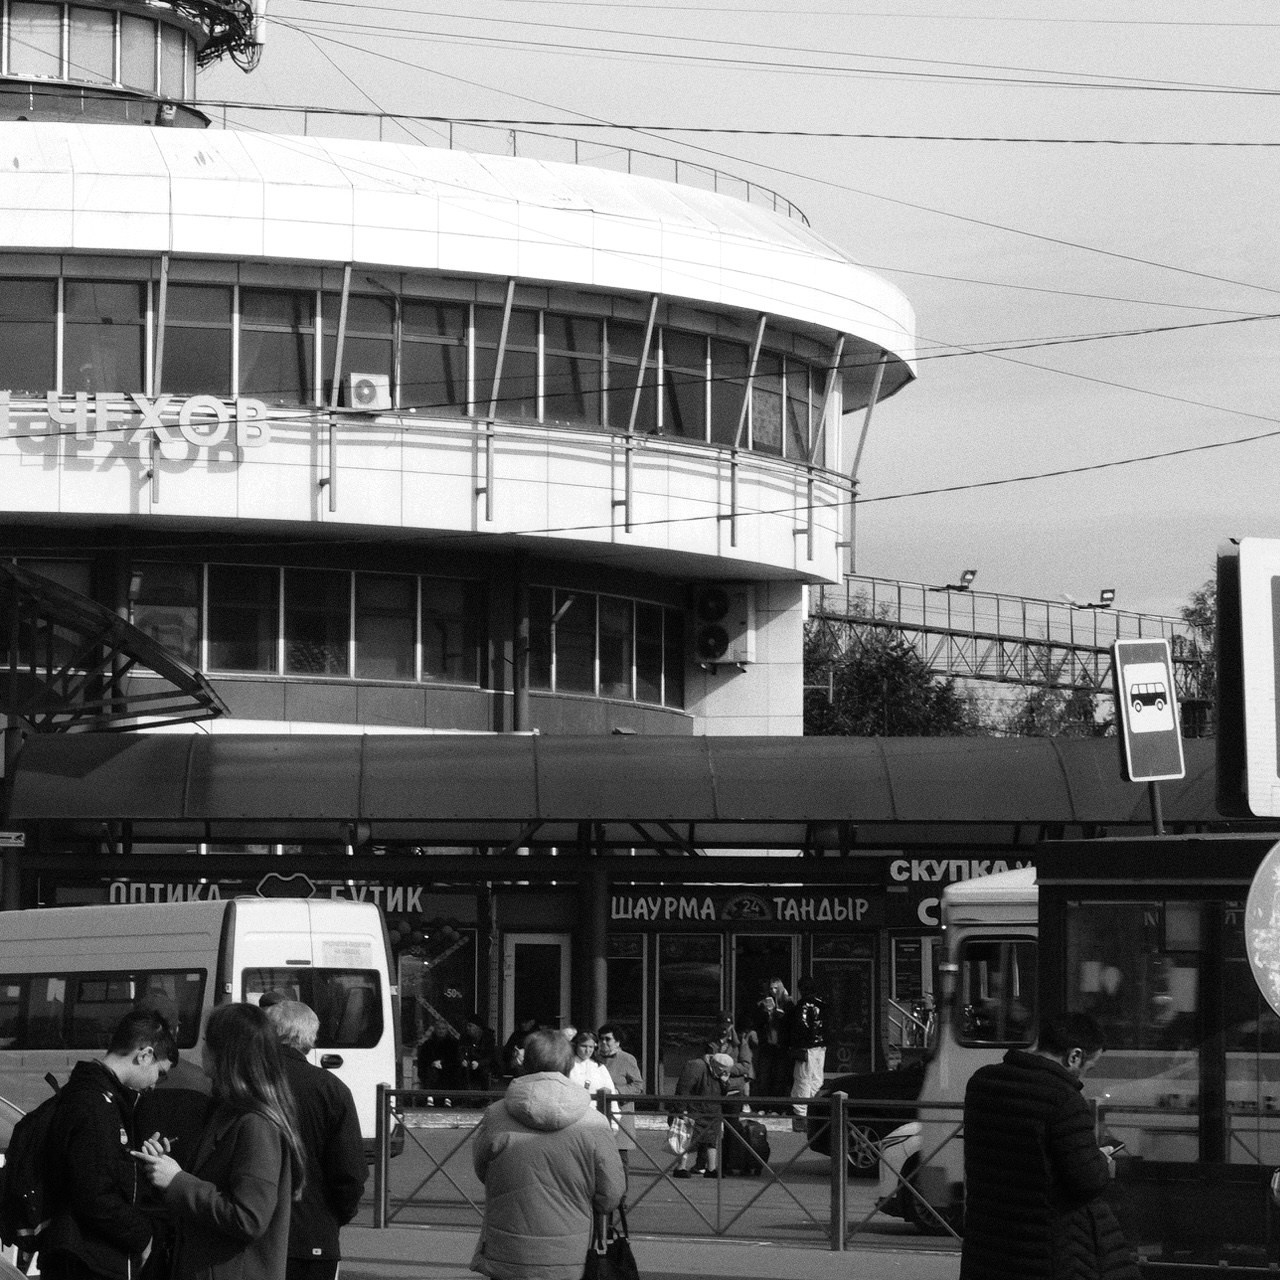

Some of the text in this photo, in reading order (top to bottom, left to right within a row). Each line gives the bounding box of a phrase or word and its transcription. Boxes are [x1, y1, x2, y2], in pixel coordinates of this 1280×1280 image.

[46, 389, 271, 449] ЧЕХОВ
[109, 881, 222, 904] ОПТИКА
[611, 895, 870, 923] ШАУРМА 24 ТАНДЫР
